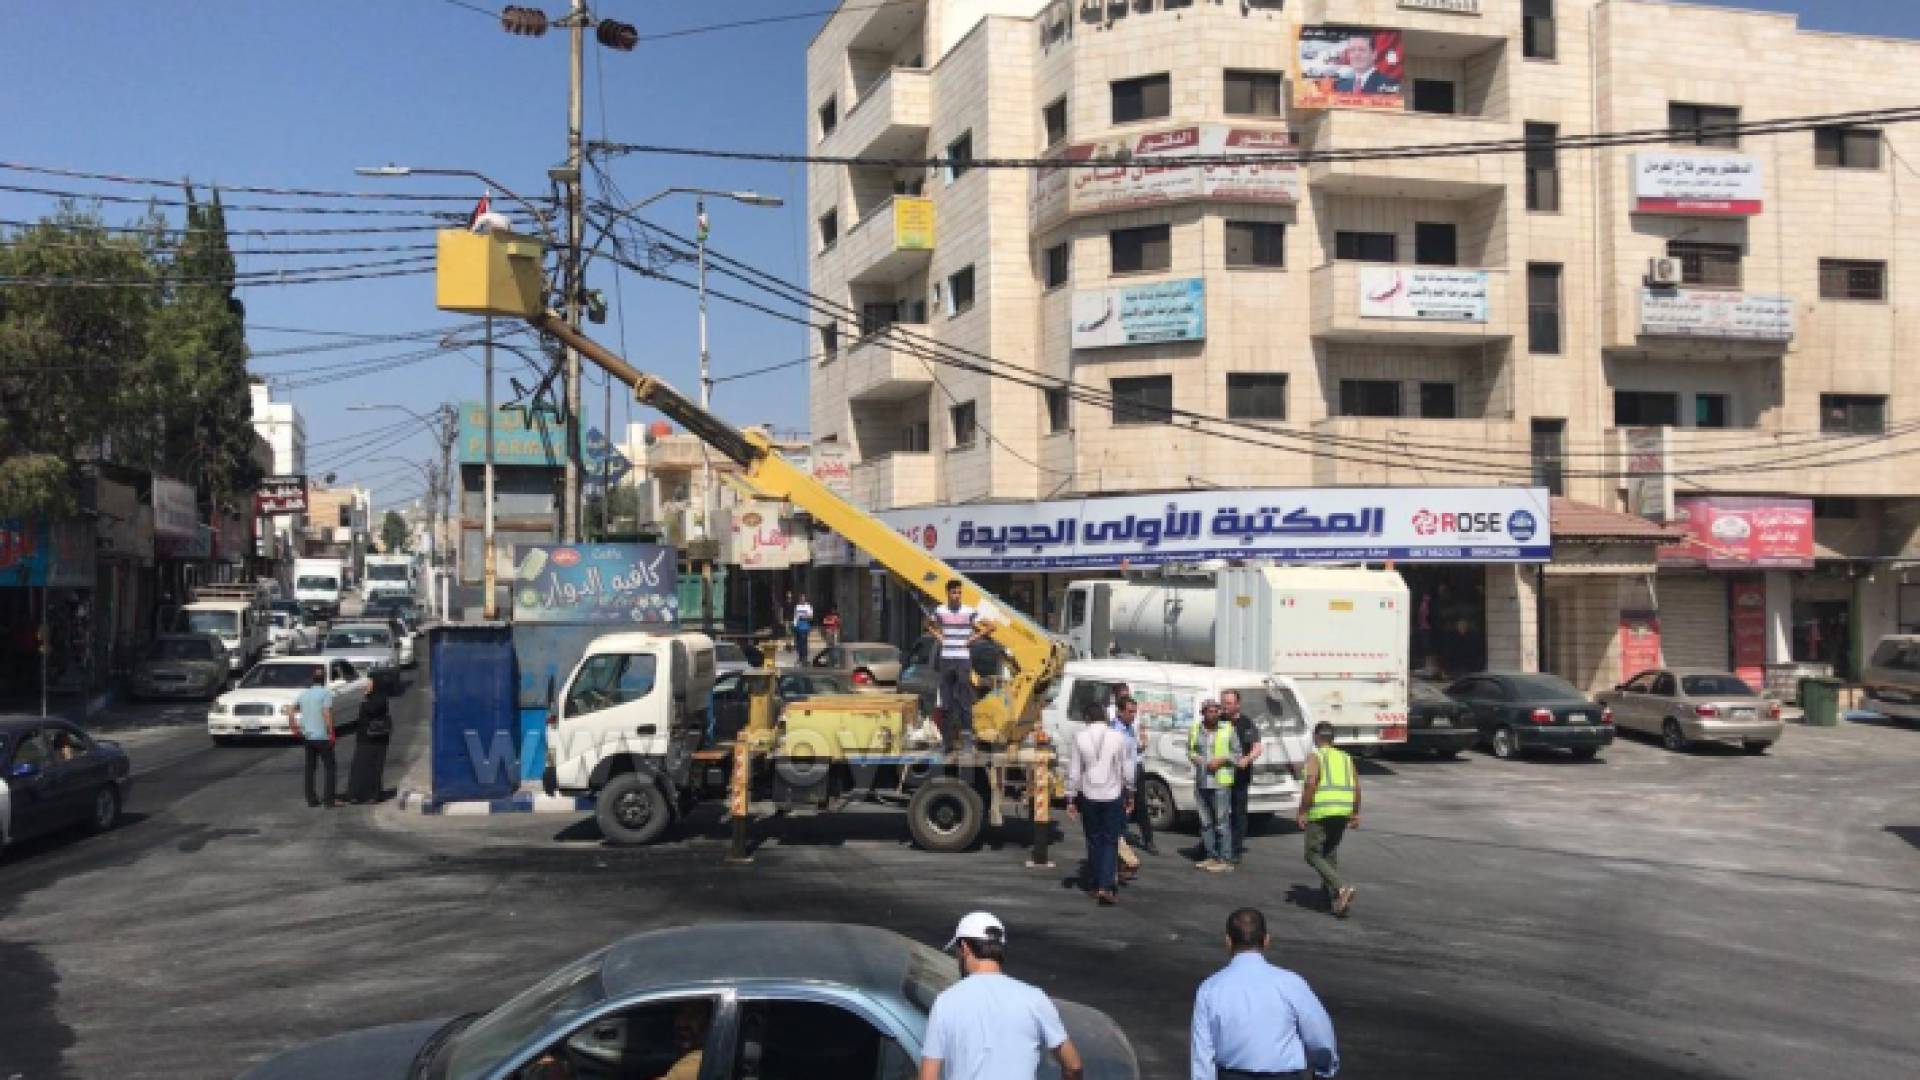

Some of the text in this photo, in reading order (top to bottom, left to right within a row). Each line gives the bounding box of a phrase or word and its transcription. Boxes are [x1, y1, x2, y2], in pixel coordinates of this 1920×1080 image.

[957, 518, 1077, 554] الجديدة
[1083, 502, 1202, 547] الأولى
[1212, 506, 1385, 546] المكتبة
[1437, 512, 1502, 533] ROSE
[612, 550, 665, 594] كافيه
